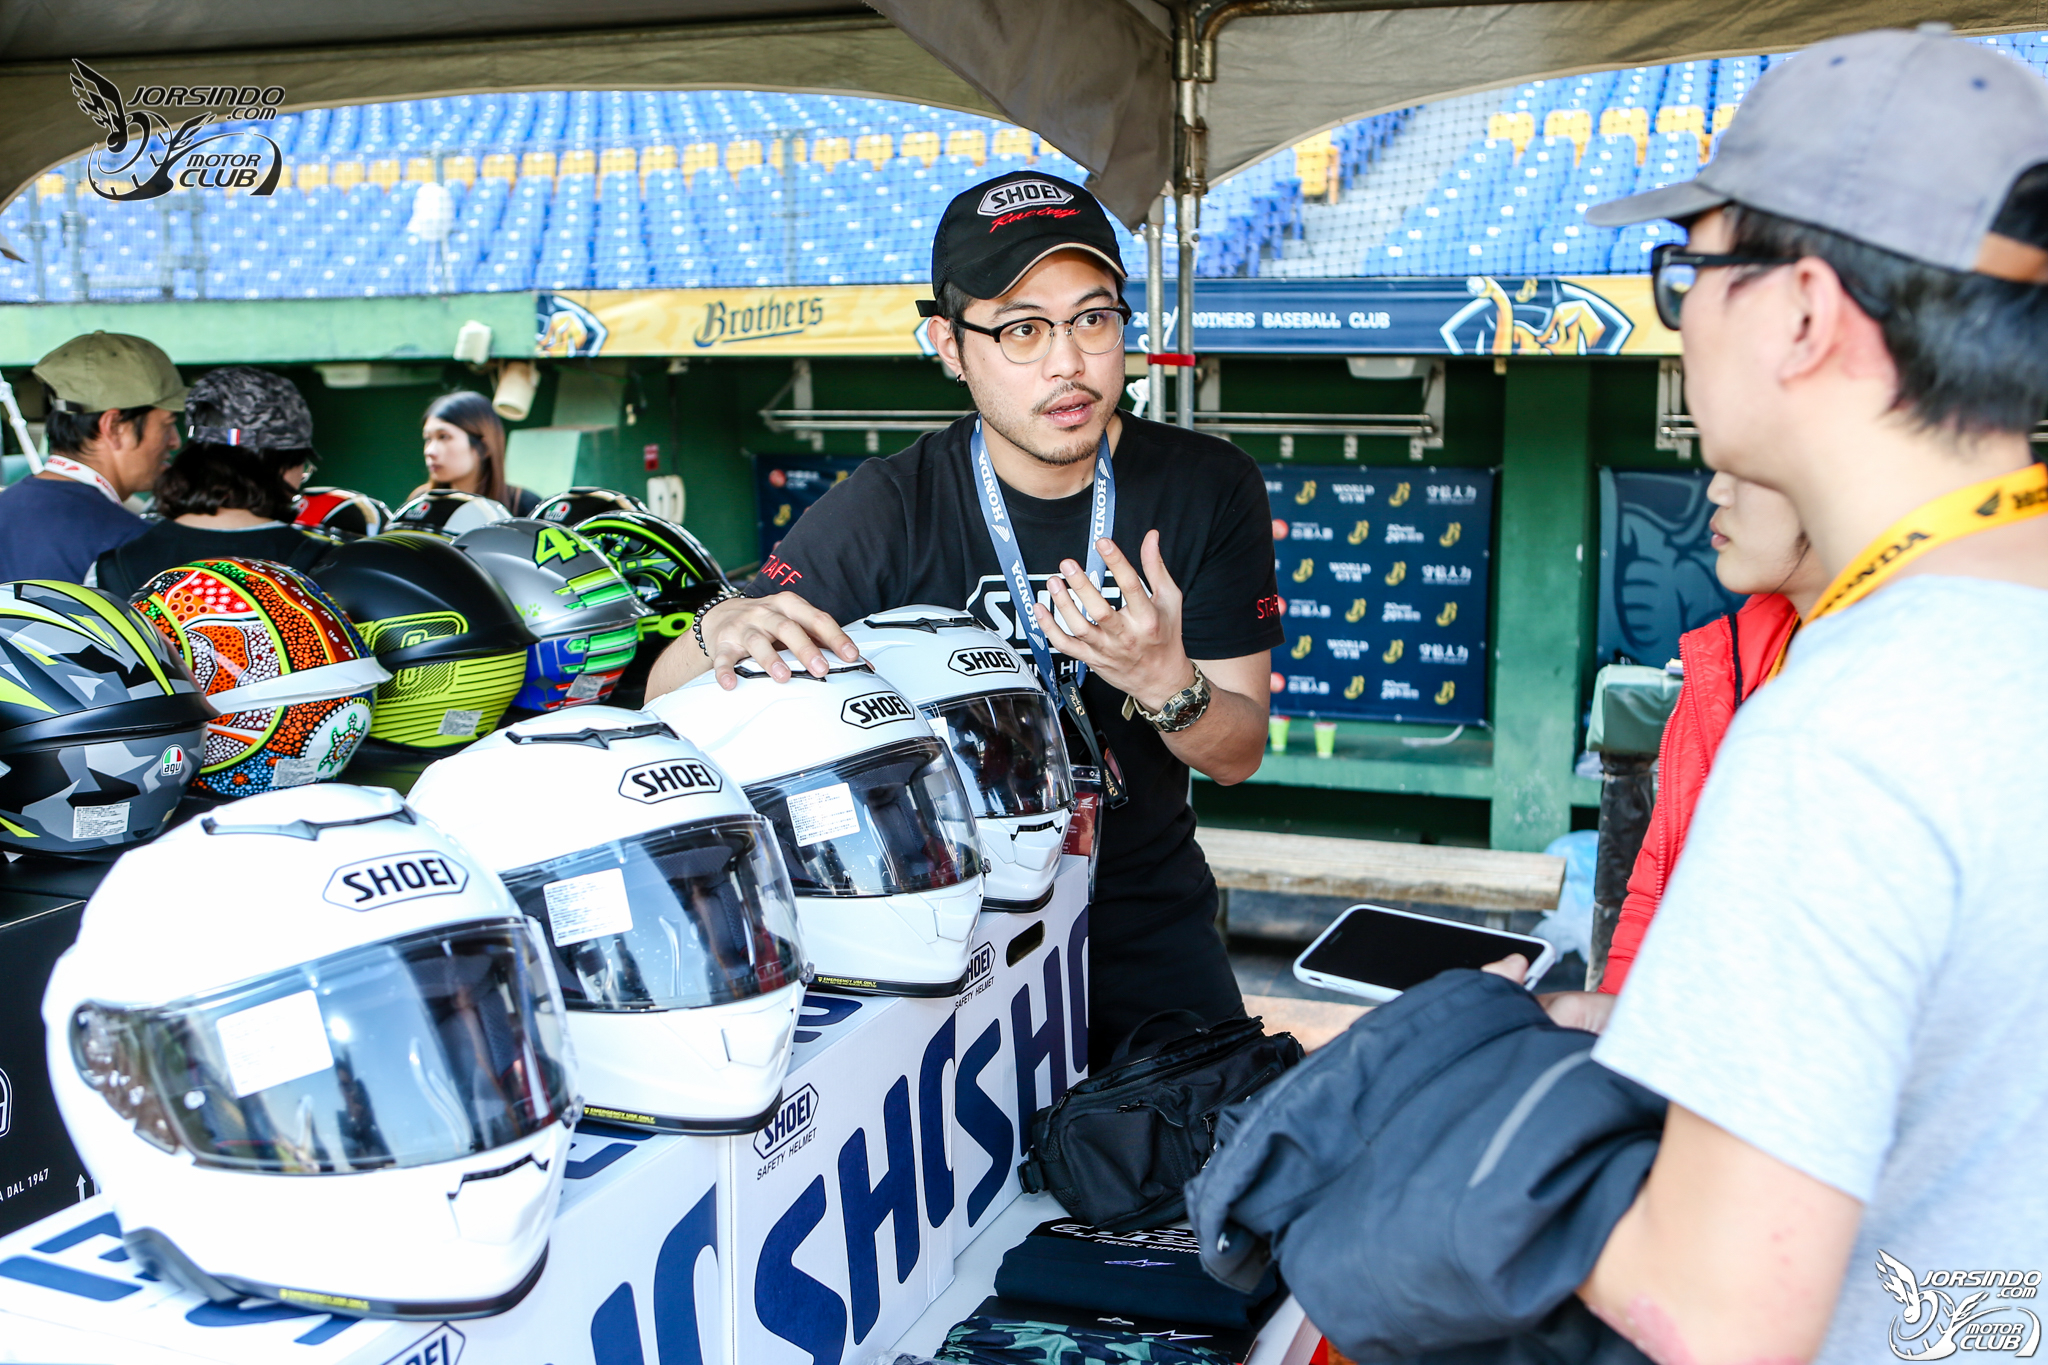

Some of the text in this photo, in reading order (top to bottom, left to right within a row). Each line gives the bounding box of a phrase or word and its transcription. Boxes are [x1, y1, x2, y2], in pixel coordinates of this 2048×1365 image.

[991, 184, 1062, 210] SHOEI
[989, 206, 1081, 233] Racing
[694, 295, 823, 348] Brothers
[1191, 312, 1256, 328] ROTHERS
[1262, 312, 1341, 329] BASEBALL
[1349, 312, 1391, 329] CLUB
[978, 450, 1004, 522] HONDA
[761, 554, 803, 586] TAFF
[1011, 560, 1040, 631] HONDA
[1256, 594, 1279, 619] STAF
[957, 651, 1016, 672] SHOEI
[849, 695, 911, 724] SHOEI
[164, 762, 182, 774] agv
[631, 763, 716, 798] SHOEI
[342, 858, 457, 903] SHOEI
[966, 947, 990, 984] HOEI
[955, 975, 995, 1009] SAFETY HELMET
[764, 1091, 811, 1151] SHOEI
[757, 1127, 817, 1181] SAFETY HELMET
[7, 1181, 25, 1199] DAL
[27, 1168, 49, 1188] 1947
